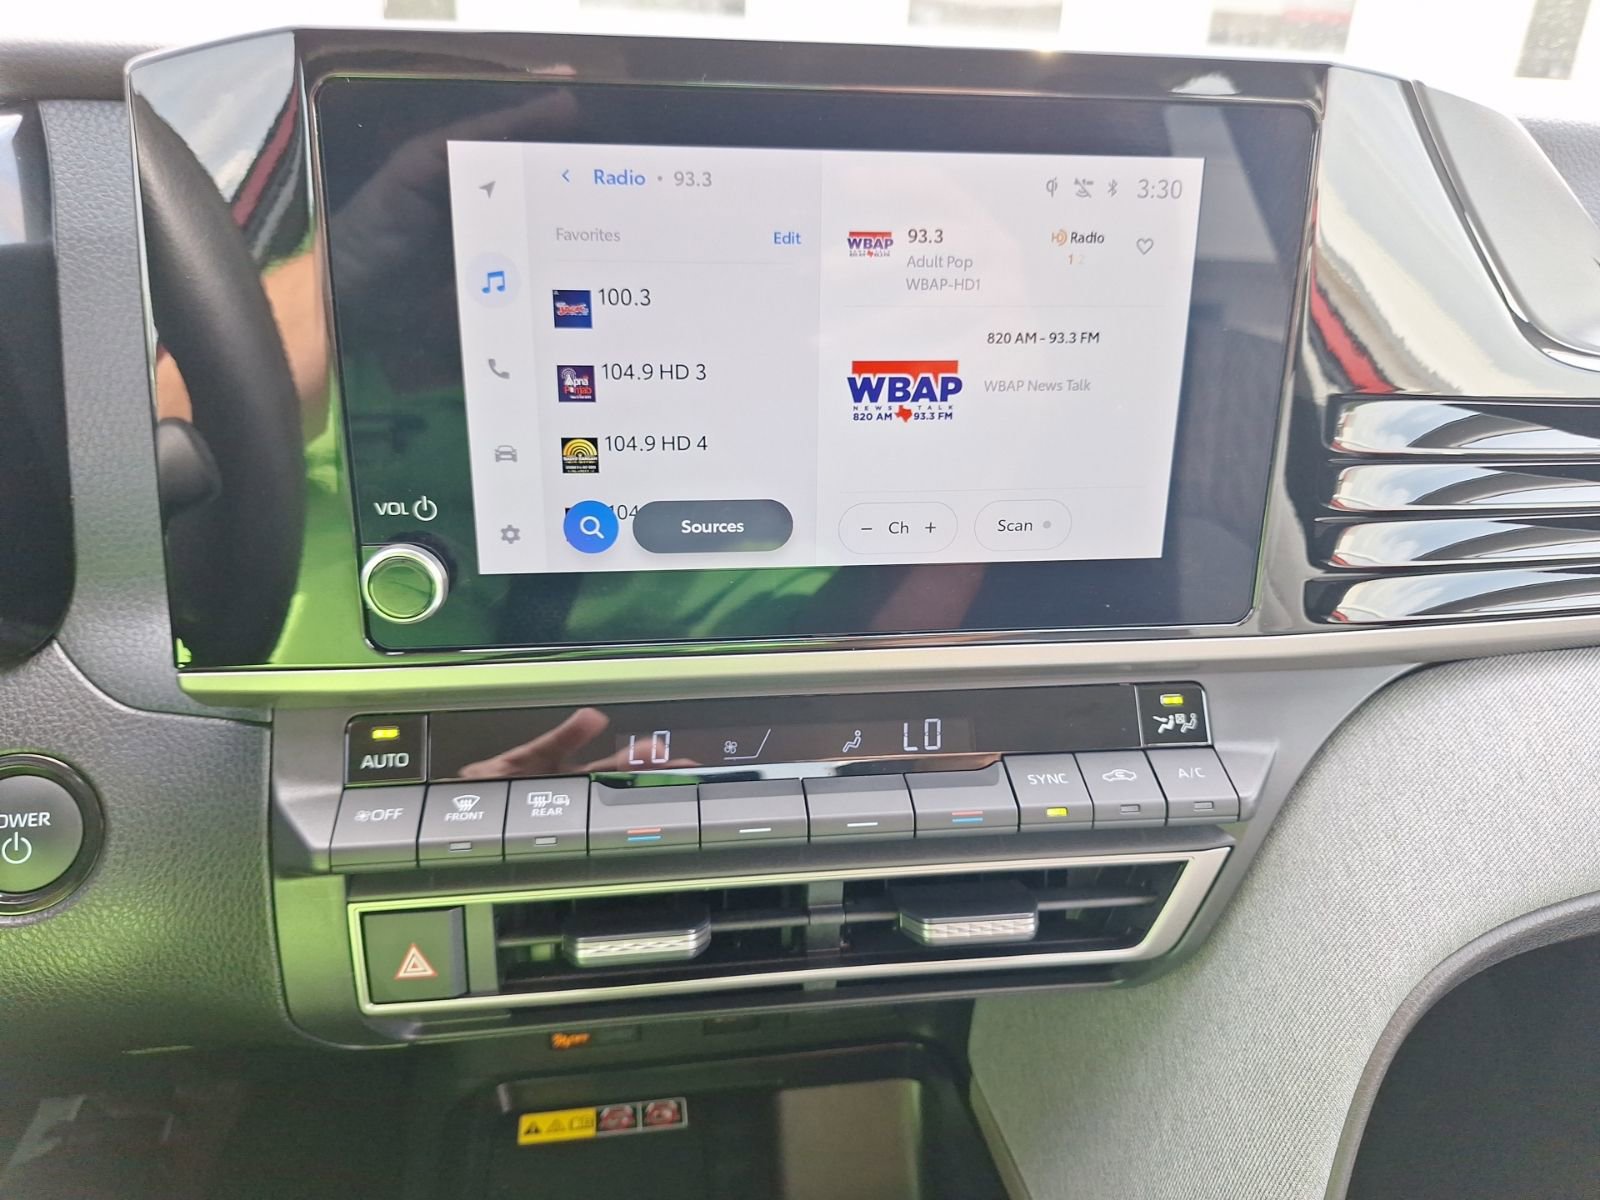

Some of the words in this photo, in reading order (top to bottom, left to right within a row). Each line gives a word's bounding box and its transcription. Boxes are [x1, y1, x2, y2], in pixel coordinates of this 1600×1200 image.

[593, 168, 646, 186] Radio
[673, 171, 713, 188] 93.3
[1136, 178, 1183, 200] 3:30
[555, 227, 621, 243] Favorites
[773, 231, 802, 245] Edit
[907, 228, 944, 244] 93.3
[1070, 231, 1105, 244] Radio
[847, 238, 894, 250] WBAP
[906, 255, 943, 268] Adult
[947, 255, 973, 270] Pop
[905, 277, 981, 292] WBAP-HD1
[598, 288, 651, 307] 100.3
[987, 331, 1012, 345] 820
[1014, 331, 1038, 344] AM
[1048, 331, 1077, 345] 93.3
[1080, 331, 1100, 344] FM
[601, 364, 653, 381] 104.9
[659, 364, 690, 380] HD
[695, 363, 707, 381] 3
[846, 376, 963, 403] WBAP
[984, 380, 1024, 393] WBAP
[1027, 380, 1063, 393] News
[1066, 379, 1091, 392] Talk
[853, 412, 873, 421] 820
[876, 412, 893, 421] AM
[913, 412, 935, 421] 93.3
[938, 412, 953, 420] FM
[604, 435, 656, 452] 104.9
[661, 435, 691, 451] HD
[696, 435, 708, 451] 4
[373, 502, 410, 516] VOL
[680, 518, 745, 534] Sources
[888, 520, 909, 535] Ch
[997, 519, 1033, 533] Scan
[360, 752, 410, 770] AUTO
[1027, 772, 1069, 785] SYNC
[1177, 766, 1205, 779] A/C
[370, 807, 404, 822] OFF
[445, 810, 485, 821] FRONT
[531, 806, 564, 817] REAR
